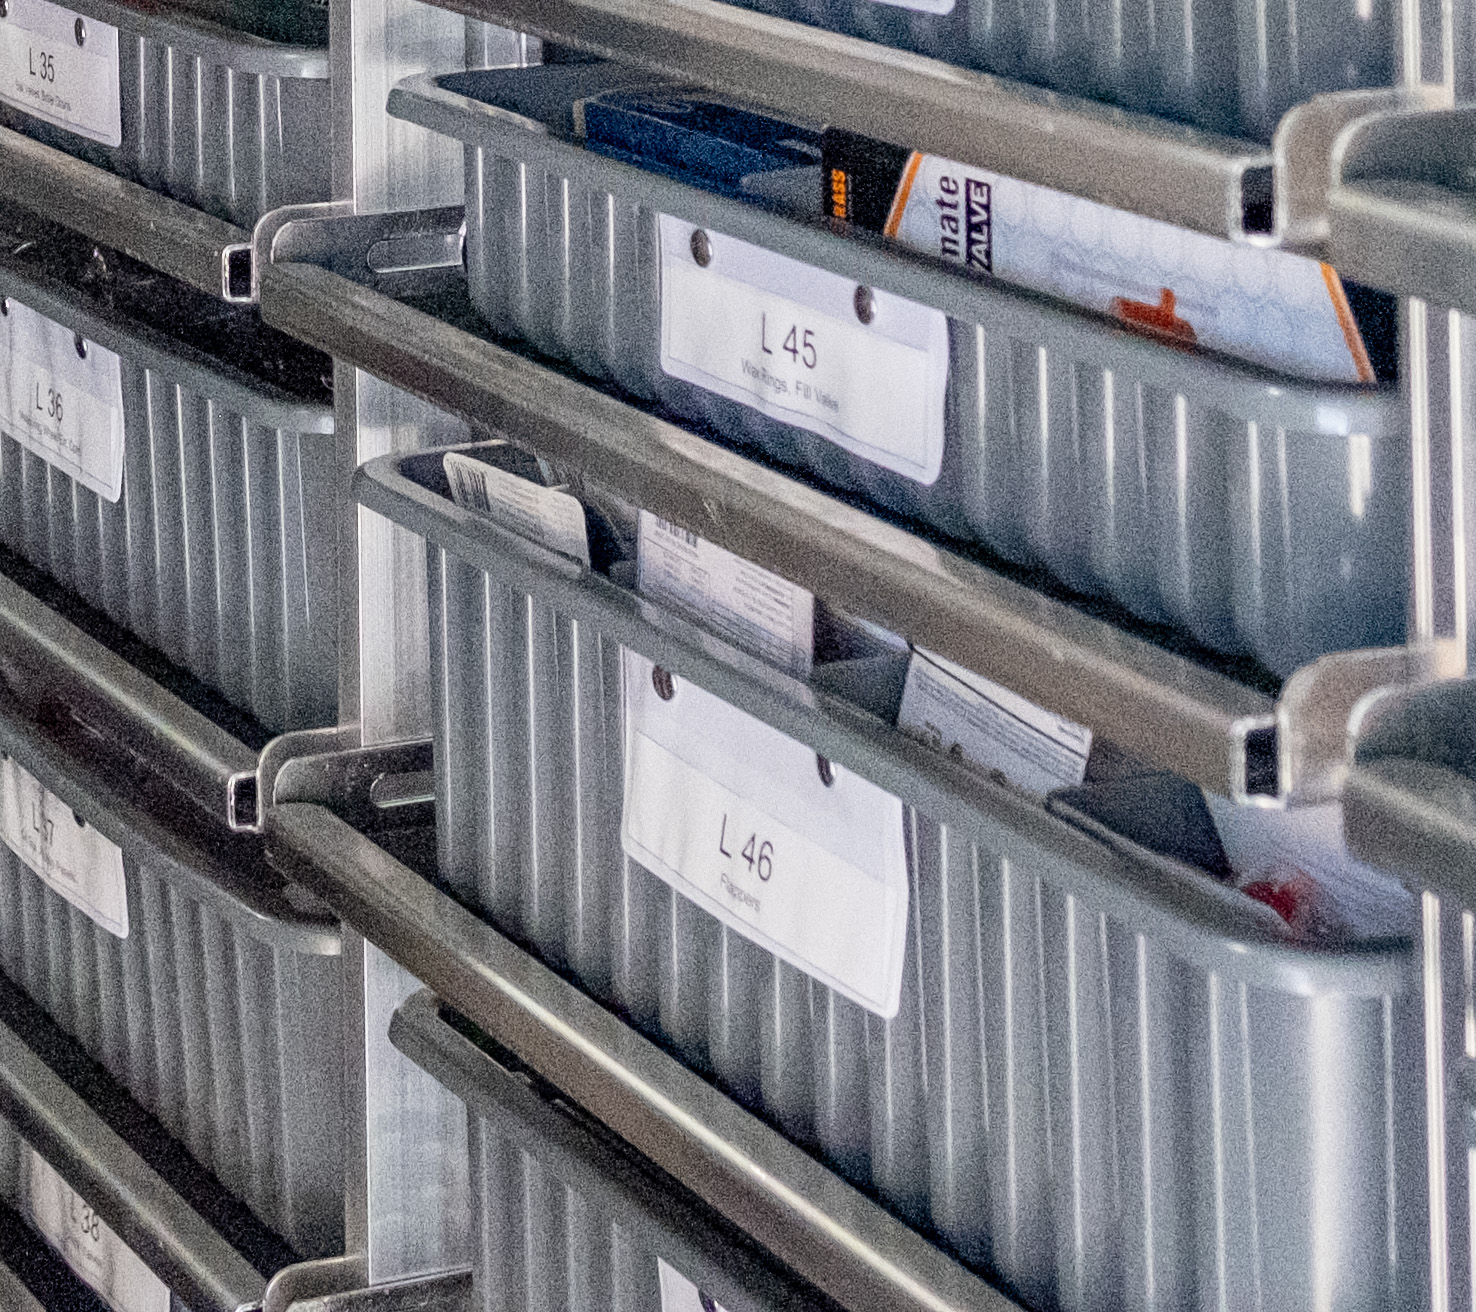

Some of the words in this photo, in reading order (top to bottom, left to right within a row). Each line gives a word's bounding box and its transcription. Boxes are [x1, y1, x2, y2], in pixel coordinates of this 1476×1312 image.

[29, 47, 36, 76] L
[40, 51, 55, 83] 35
[969, 181, 990, 269] ALVE
[762, 312, 773, 355] L
[783, 324, 817, 369] 45
[36, 381, 43, 411] L
[48, 388, 64, 422] 36
[32, 801, 40, 833] L
[720, 813, 732, 859] L
[742, 833, 774, 882] 46
